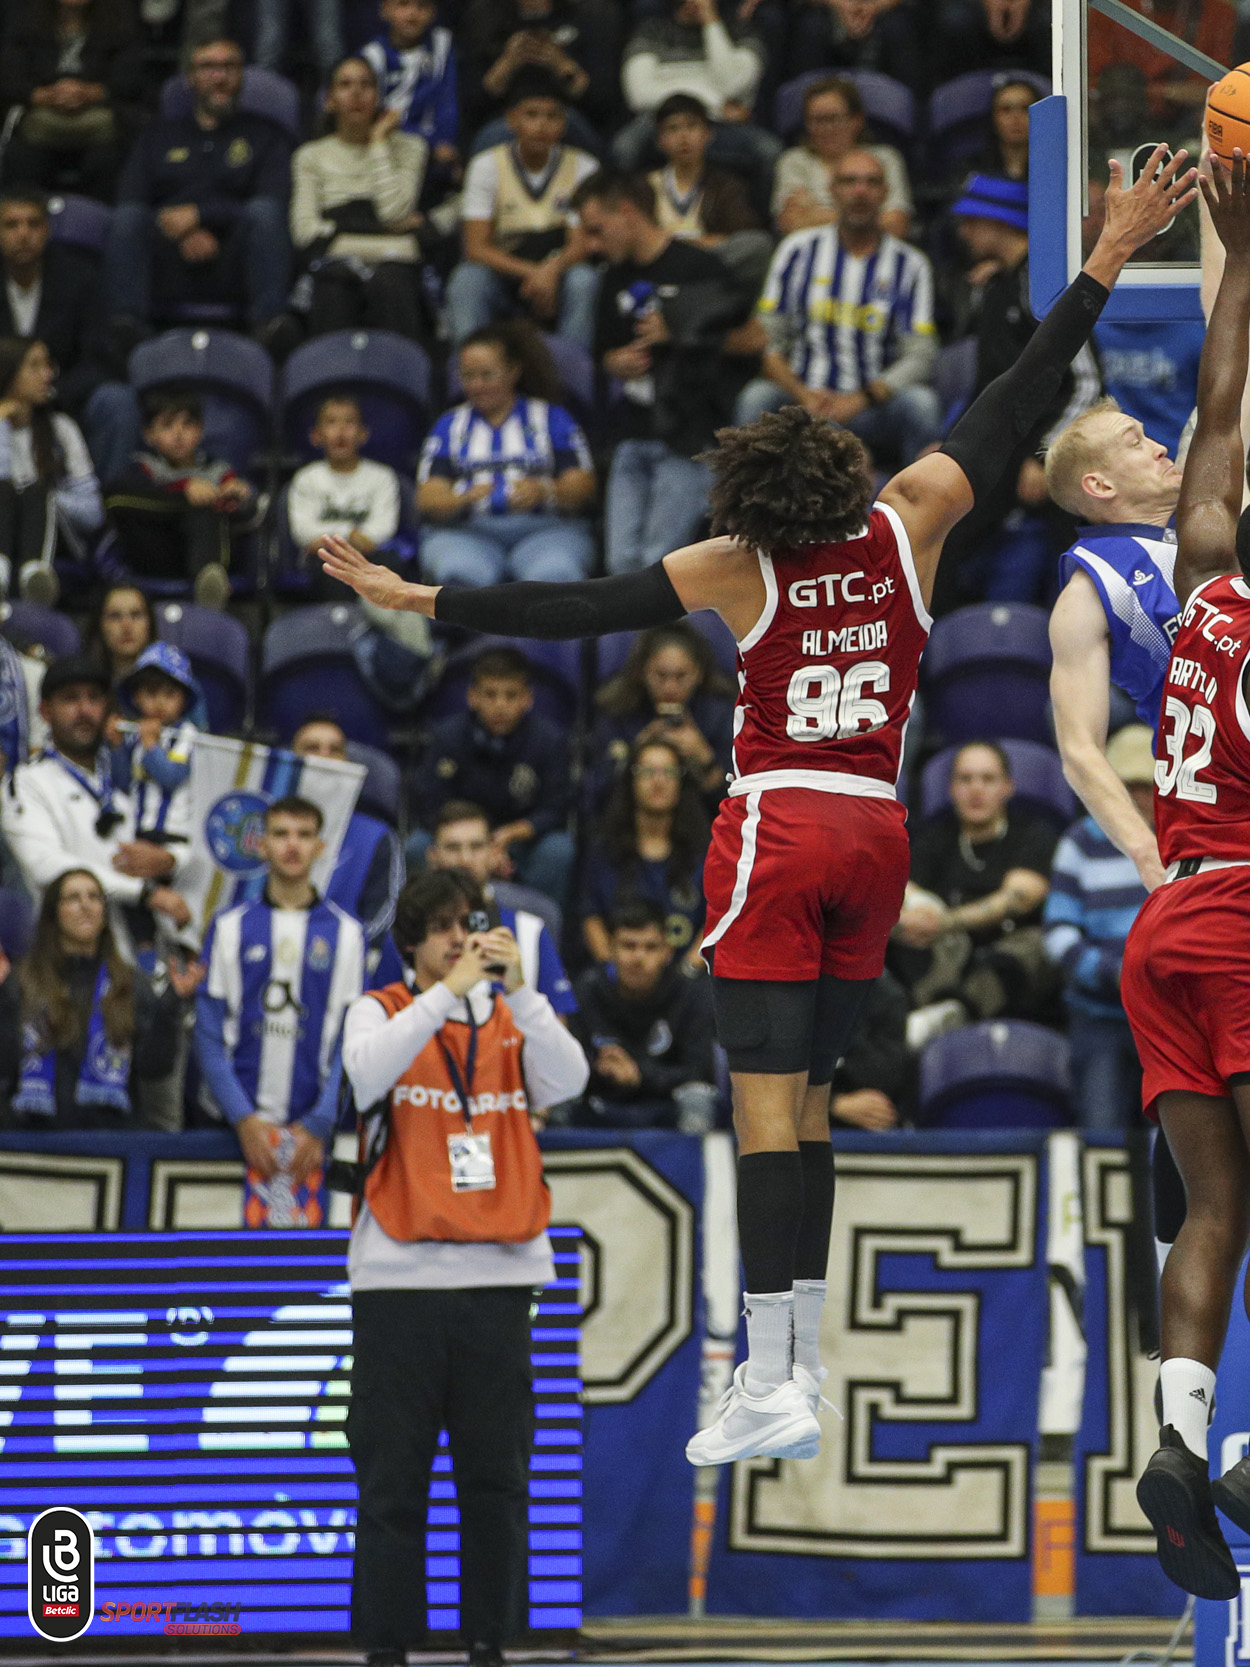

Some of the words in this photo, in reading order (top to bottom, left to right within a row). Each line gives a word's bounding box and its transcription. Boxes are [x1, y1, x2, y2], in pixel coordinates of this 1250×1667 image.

[787, 570, 896, 608] GTC.pt
[801, 619, 889, 656] ALMEIDA
[785, 660, 891, 743] 96
[1153, 695, 1218, 805] 32
